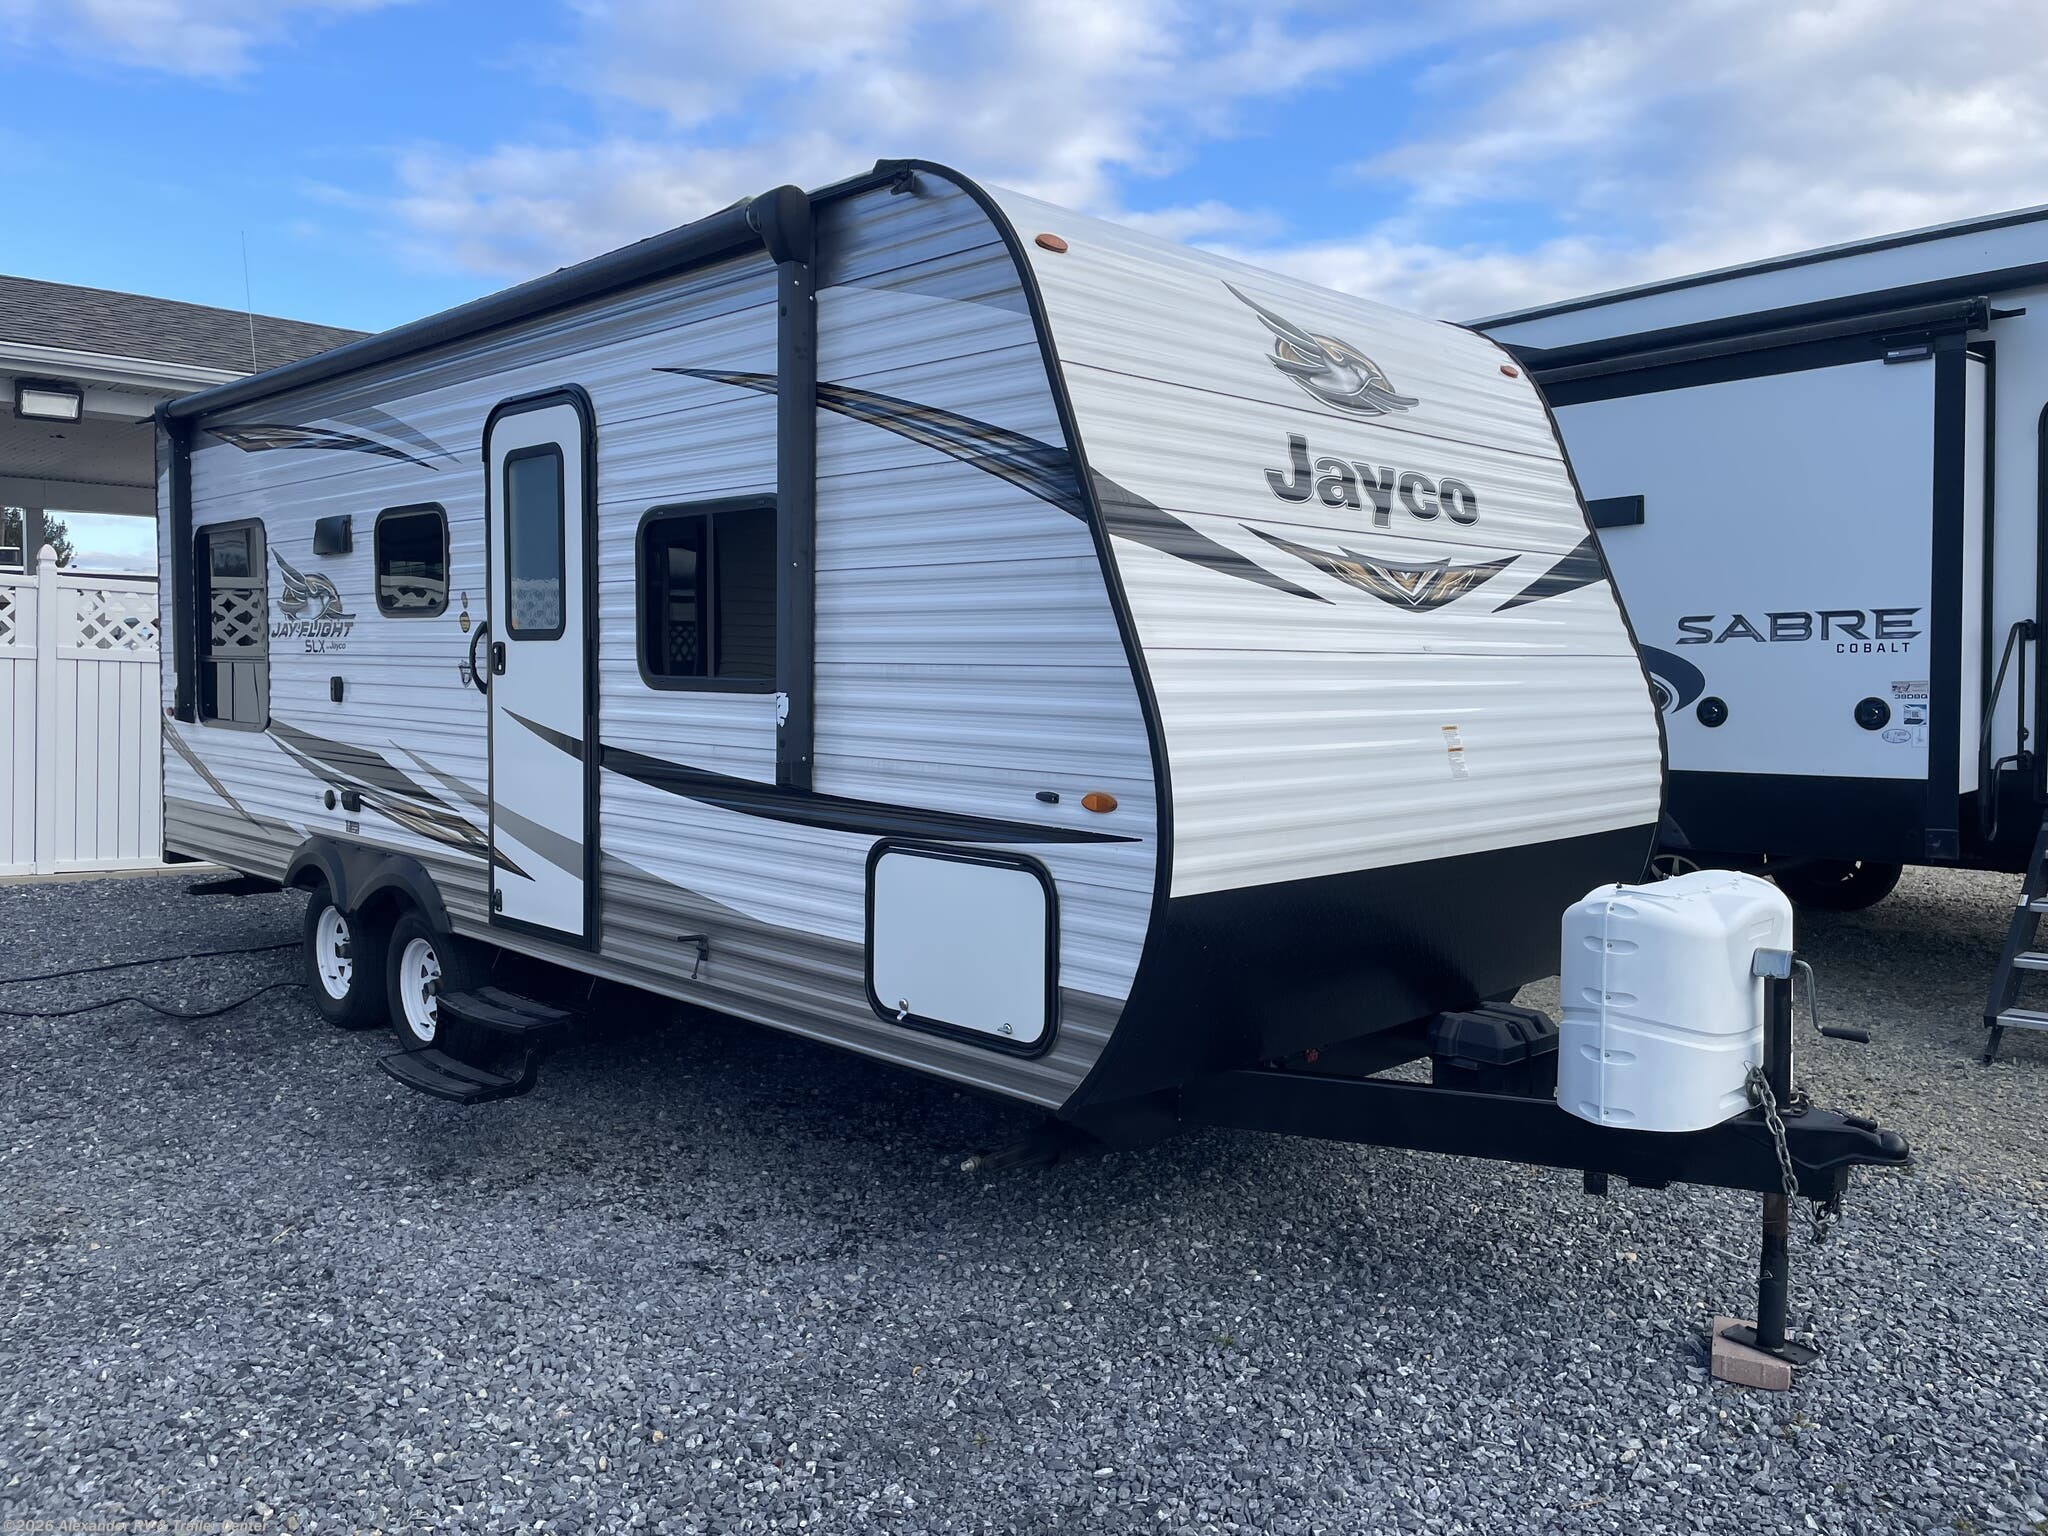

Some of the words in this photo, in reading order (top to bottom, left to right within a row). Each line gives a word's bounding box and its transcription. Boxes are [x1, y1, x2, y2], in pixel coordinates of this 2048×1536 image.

[1264, 432, 1480, 529] Jayco
[1675, 607, 1923, 645] SABRE
[305, 639, 325, 653] SLX
[1836, 642, 1910, 654] COBALT
